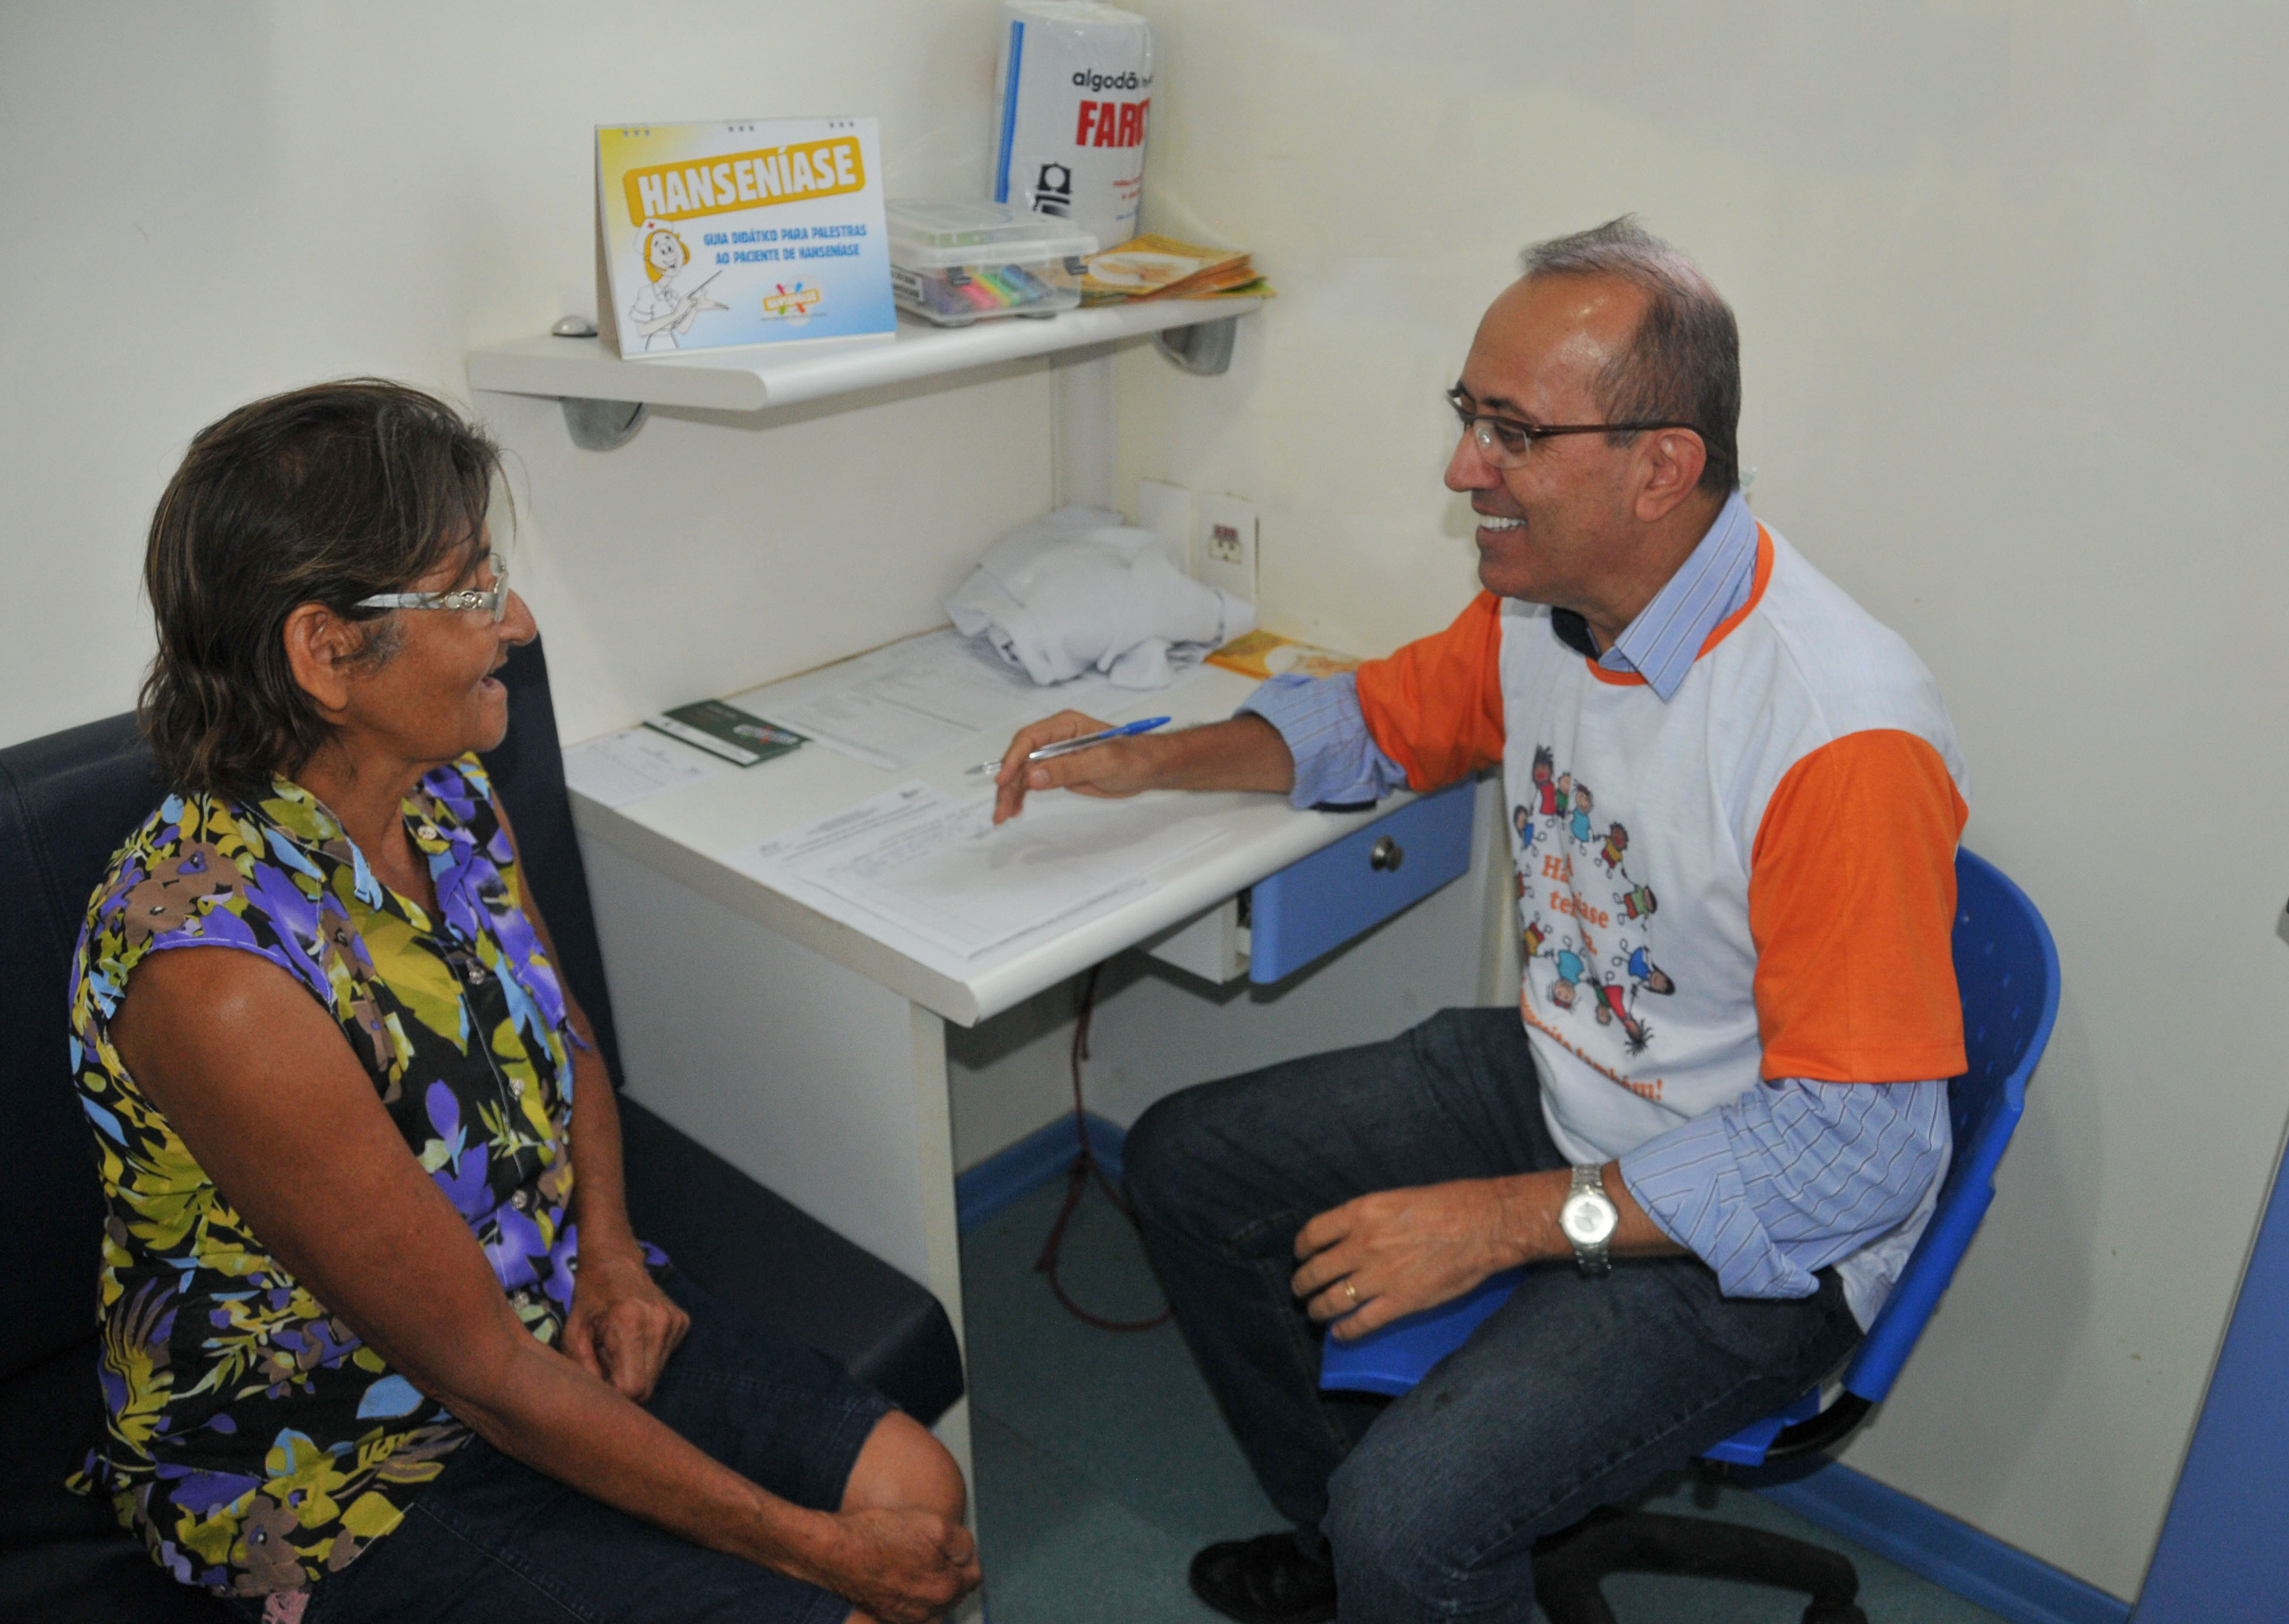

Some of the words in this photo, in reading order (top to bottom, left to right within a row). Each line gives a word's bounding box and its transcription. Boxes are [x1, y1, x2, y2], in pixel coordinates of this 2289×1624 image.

[638, 145, 857, 216] HANSENÍASE
[703, 233, 728, 246] GUIA
[731, 228, 777, 243] DIDÁTICO
[781, 228, 809, 240] PARA
[812, 224, 867, 238] PALESTRAS
[716, 252, 730, 264] AO
[733, 249, 779, 263] PACIENTE
[782, 247, 796, 260] DE
[798, 243, 860, 259] HANSENÍASE
